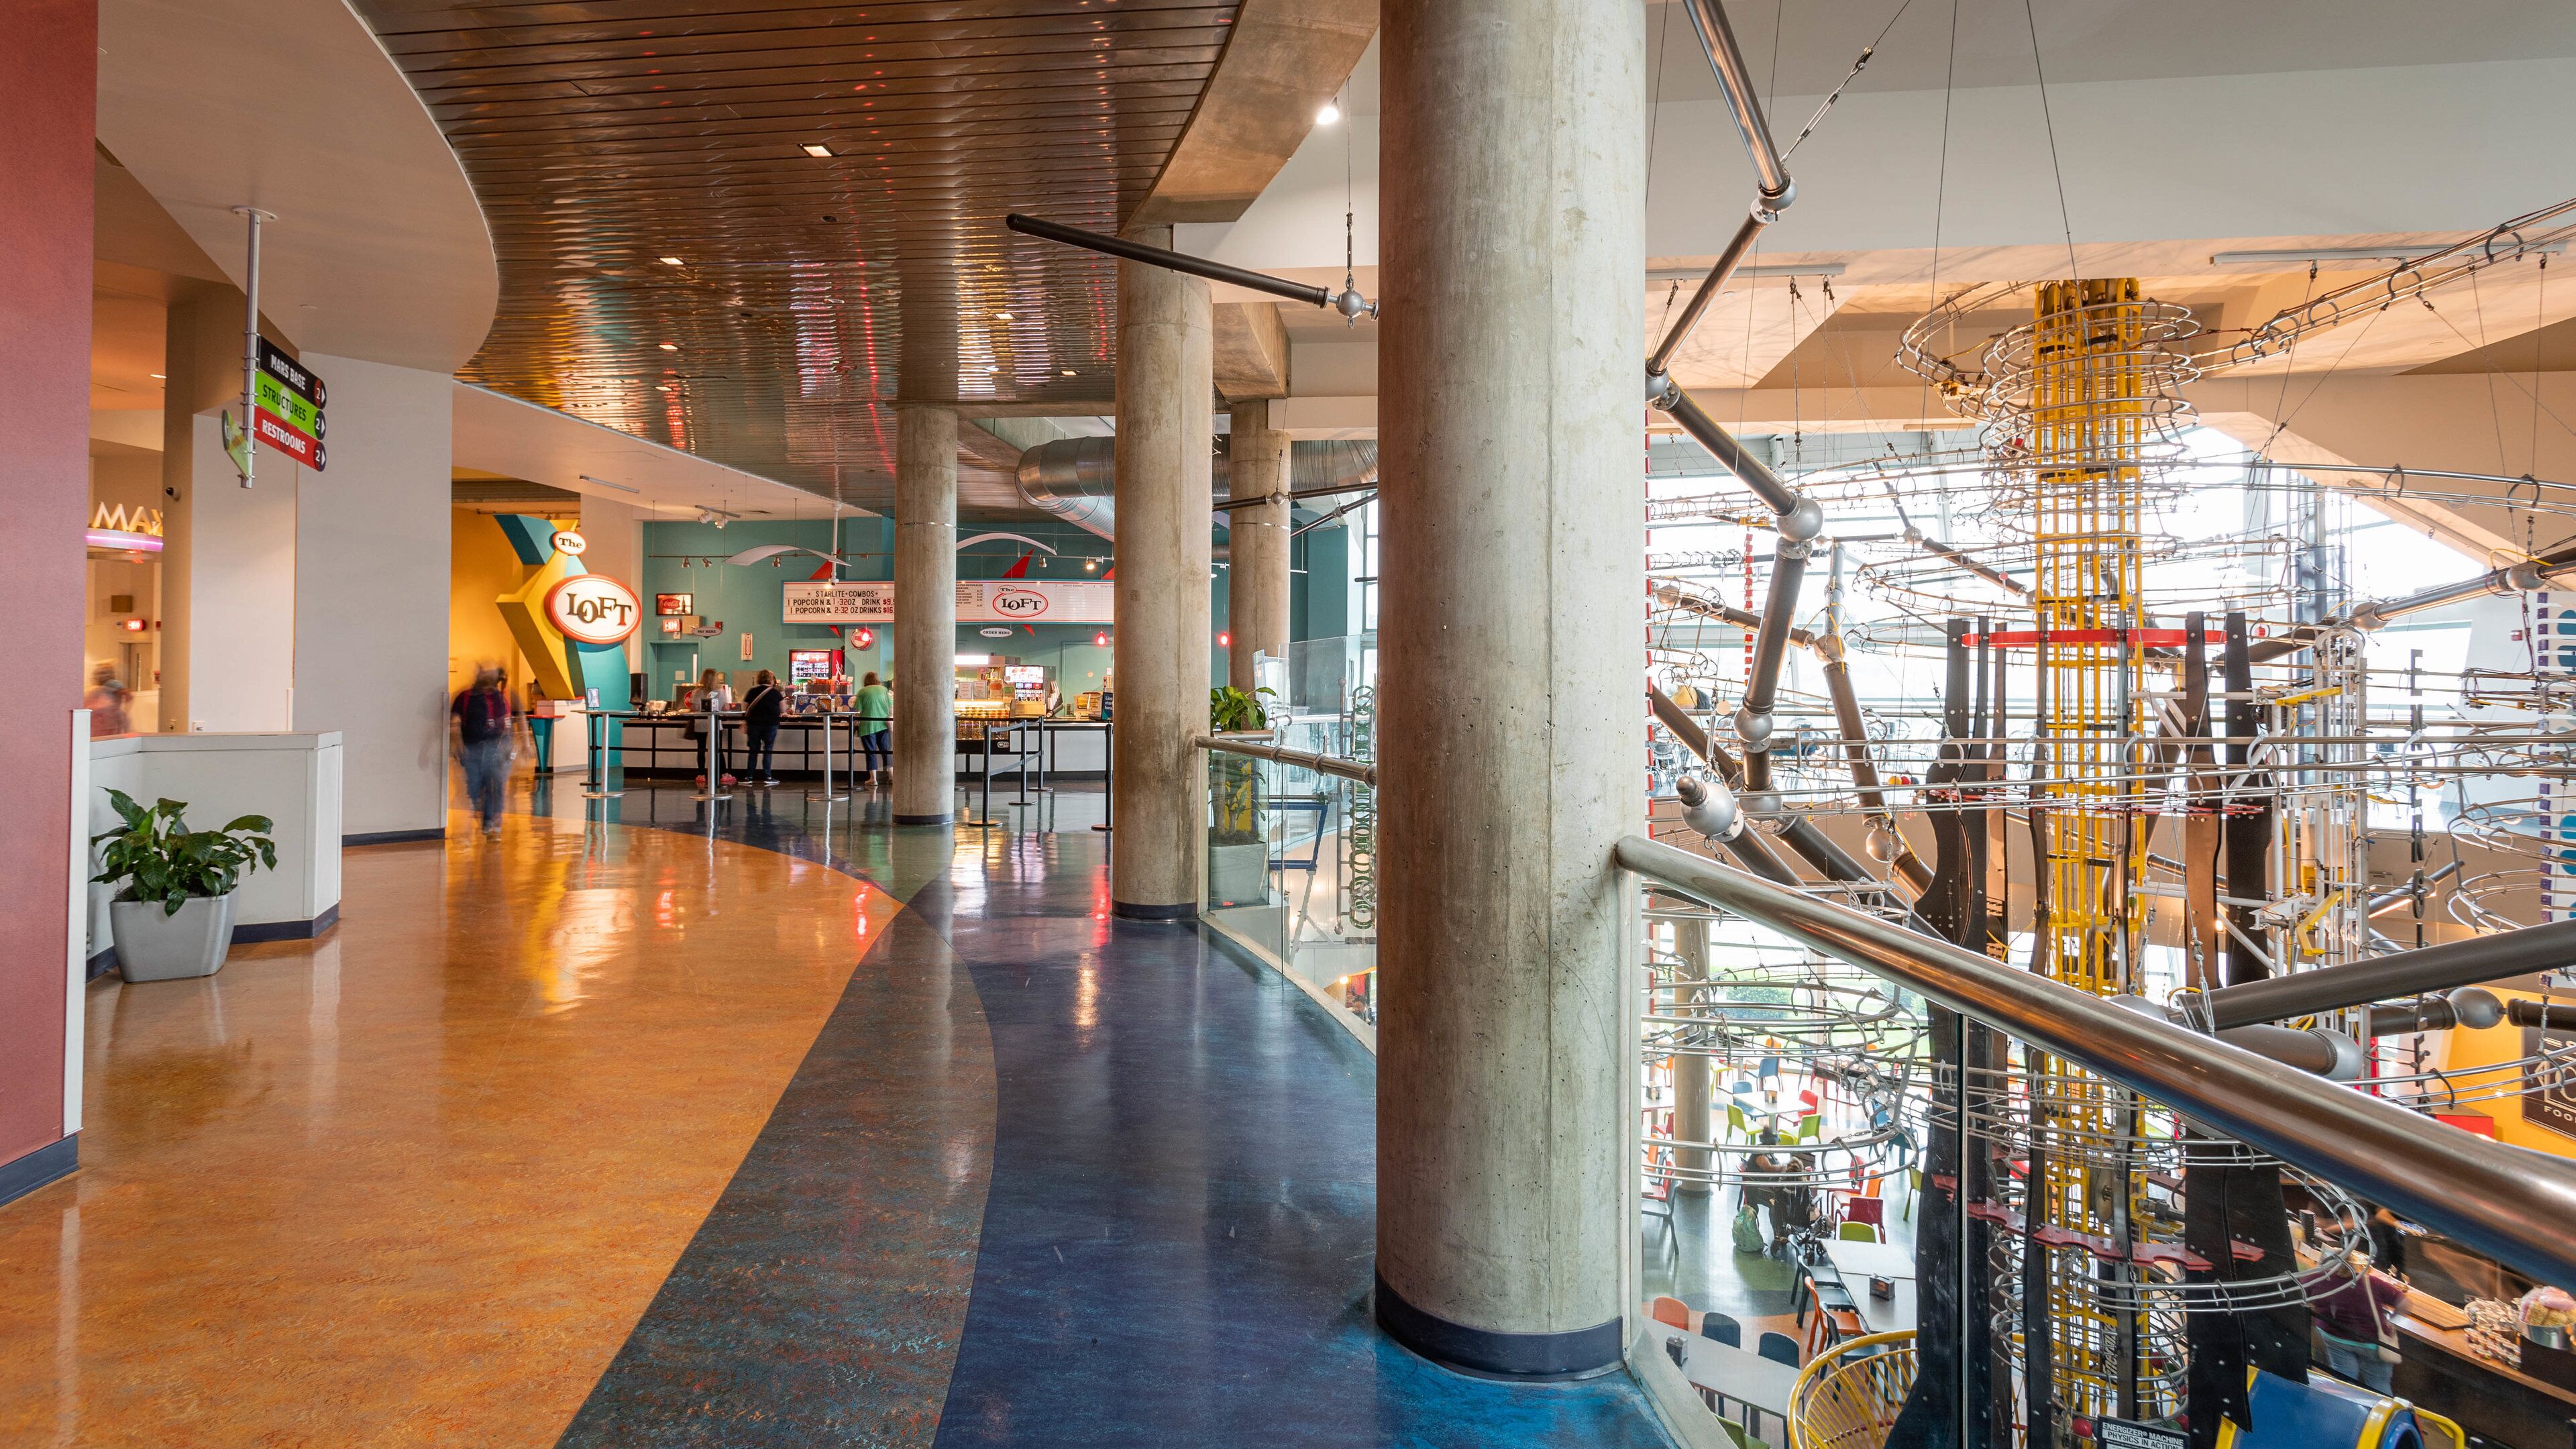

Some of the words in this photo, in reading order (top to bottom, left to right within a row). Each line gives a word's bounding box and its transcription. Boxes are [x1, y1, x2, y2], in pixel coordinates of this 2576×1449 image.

[270, 354, 289, 380] MARS
[290, 368, 306, 390] BASE
[316, 388, 321, 399] 2
[263, 384, 307, 421] STRUCTURES
[315, 418, 320, 429] 2
[262, 419, 306, 454] RESTROOMS
[315, 450, 320, 462] 2
[559, 537, 582, 549] The
[566, 592, 632, 627] LOFT
[1002, 598, 1042, 610] LOFT
[2544, 1106, 2576, 1124] FOO
[2108, 1431, 2139, 1444] PHYSICS
[2141, 1438, 2149, 1446] IN
[2149, 1432, 2184, 1446] MACHINE
